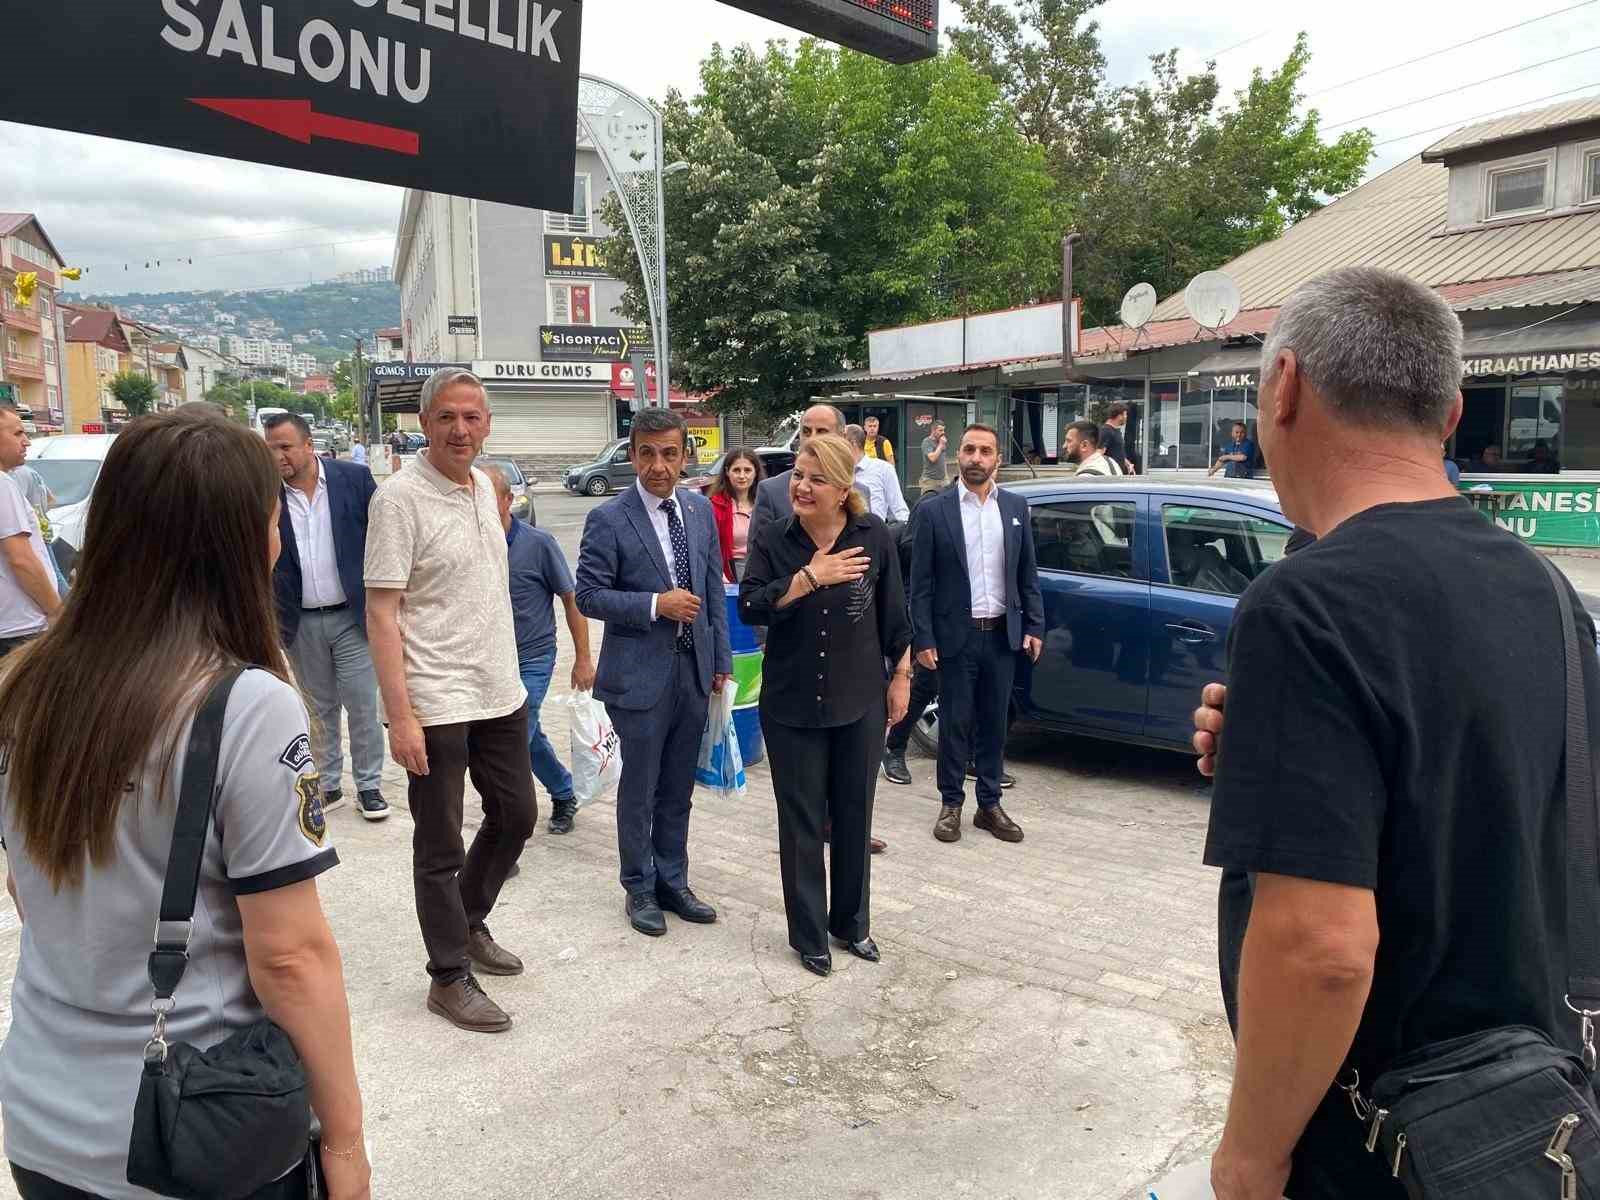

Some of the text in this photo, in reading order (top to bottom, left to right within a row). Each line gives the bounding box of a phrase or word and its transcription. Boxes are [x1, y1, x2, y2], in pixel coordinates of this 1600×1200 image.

[160, 0, 431, 103] SALONU
[495, 364, 592, 378] DURU GÜMÜŞ
[1213, 374, 1255, 387] Y.M.K.
